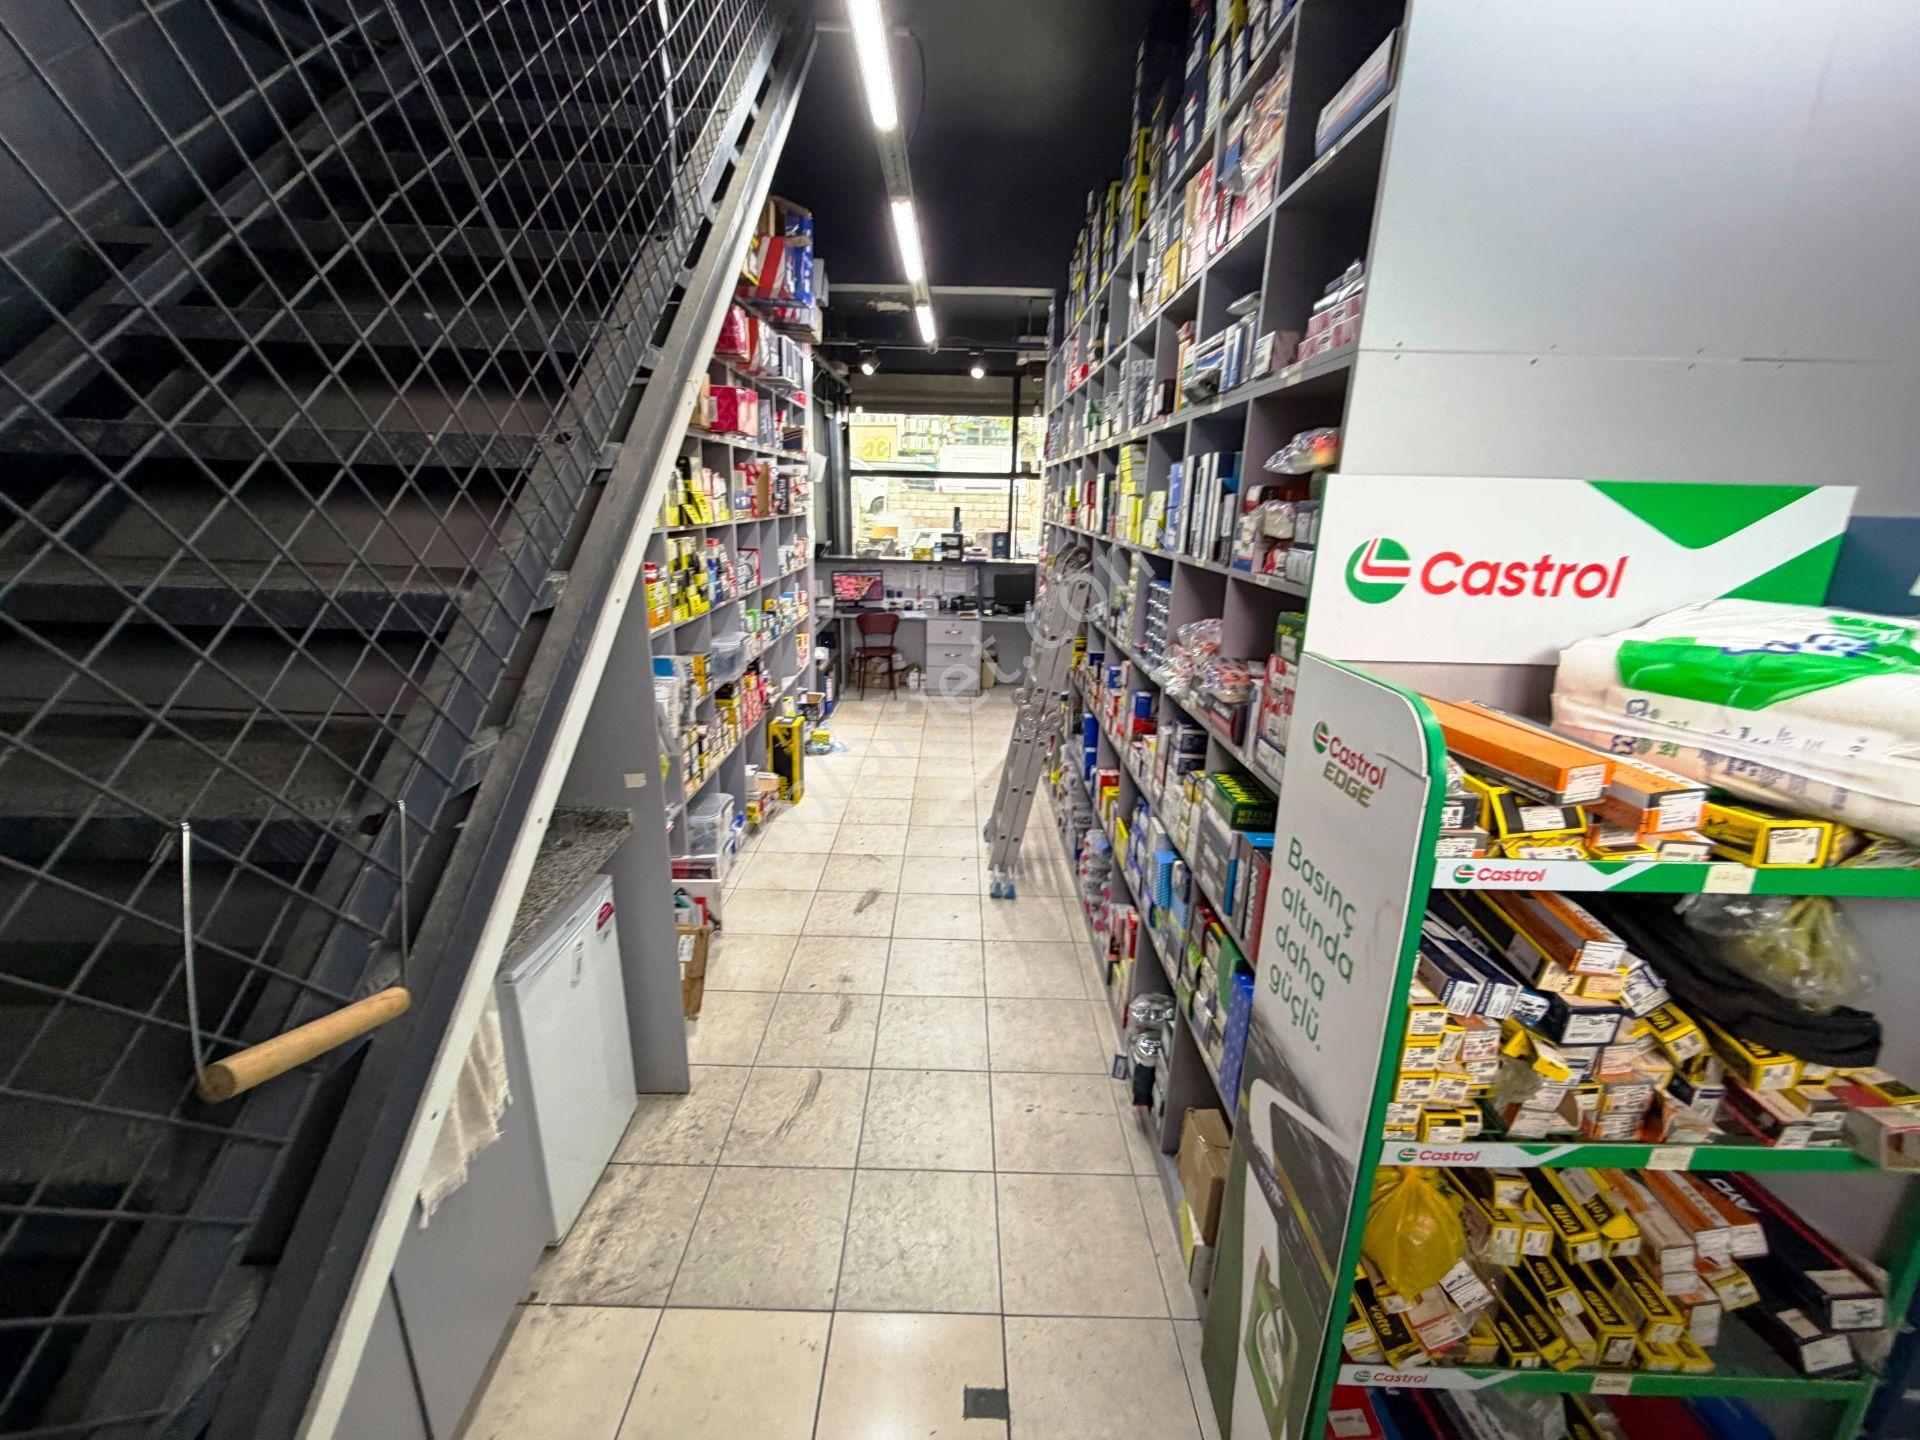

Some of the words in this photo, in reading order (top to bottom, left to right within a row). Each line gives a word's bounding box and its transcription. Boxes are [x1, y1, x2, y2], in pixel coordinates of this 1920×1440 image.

[1420, 551, 1629, 599] Castrol
[1322, 761, 1375, 808] EDGE
[1328, 735, 1387, 790] Castrol
[1287, 837, 1357, 938] Basınç
[1477, 867, 1547, 882] Castrol
[1281, 886, 1354, 984] altında
[1276, 925, 1325, 1001] daha
[1269, 963, 1322, 1052] güçlü.
[1419, 1149, 1480, 1163] Castrol
[1551, 1203, 1580, 1234] Votto
[1369, 1304, 1394, 1336] Votto
[1373, 1372, 1427, 1384] Castrol
